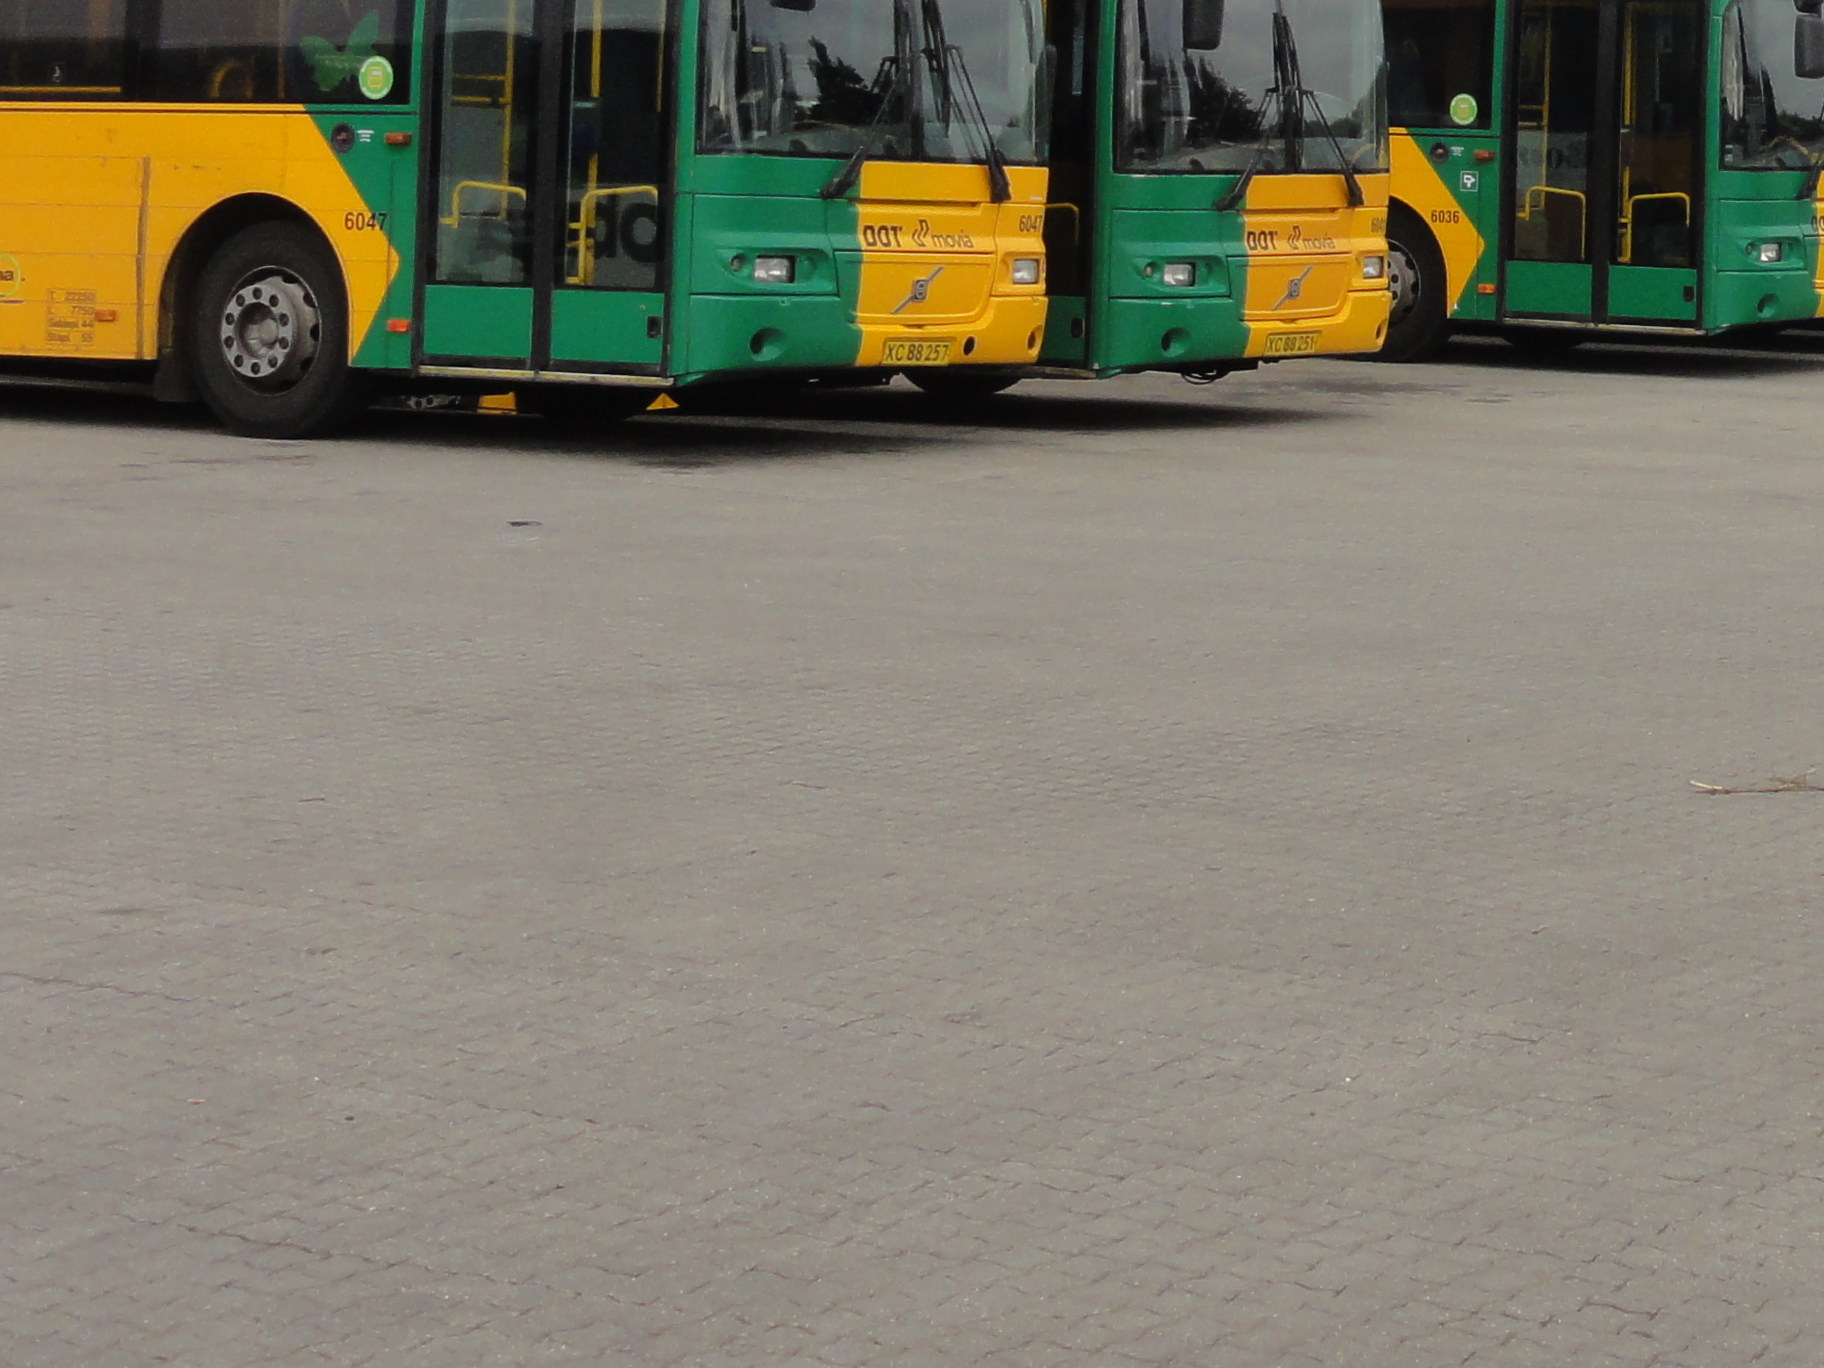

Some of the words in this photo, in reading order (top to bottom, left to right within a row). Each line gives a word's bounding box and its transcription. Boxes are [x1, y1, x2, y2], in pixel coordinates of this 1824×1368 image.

[344, 211, 388, 231] 6047
[1018, 215, 1043, 232] 6047
[1430, 210, 1460, 224] 6036
[863, 224, 903, 248] DOT
[931, 229, 974, 248] movia
[1246, 229, 1278, 251] DOT
[1303, 232, 1336, 250] movia
[885, 344, 904, 363] XC
[907, 344, 923, 362] 88
[926, 343, 949, 362] 257
[1266, 336, 1283, 353] XC
